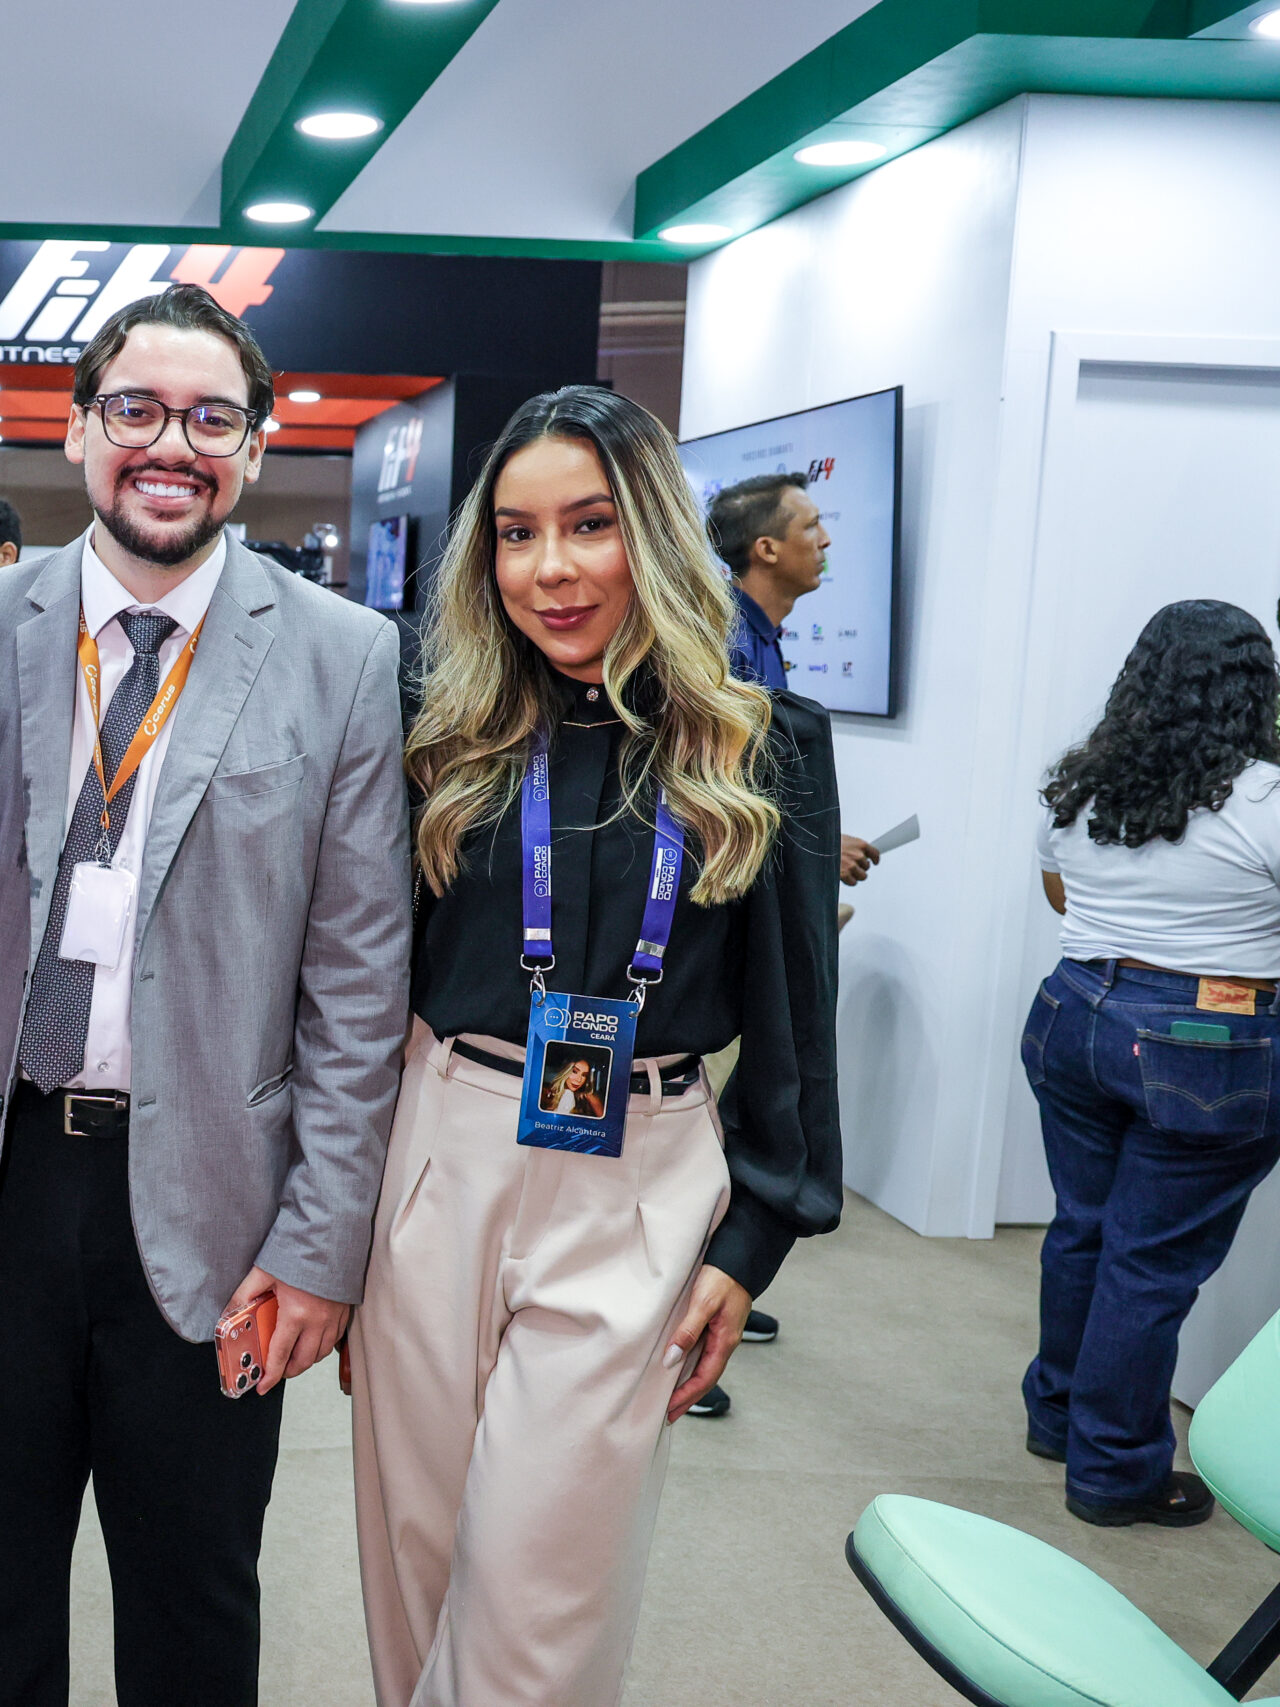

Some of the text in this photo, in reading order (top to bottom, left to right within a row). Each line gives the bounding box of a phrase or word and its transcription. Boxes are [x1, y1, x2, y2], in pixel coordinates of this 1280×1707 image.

[152, 684, 176, 723] cerus
[657, 865, 669, 900] CONDO
[664, 866, 676, 901] PAPO
[573, 1011, 619, 1025] PAPO
[572, 1020, 618, 1033] CONDO
[590, 1032, 616, 1042] CEARÁ
[534, 1121, 564, 1132] Beatriz
